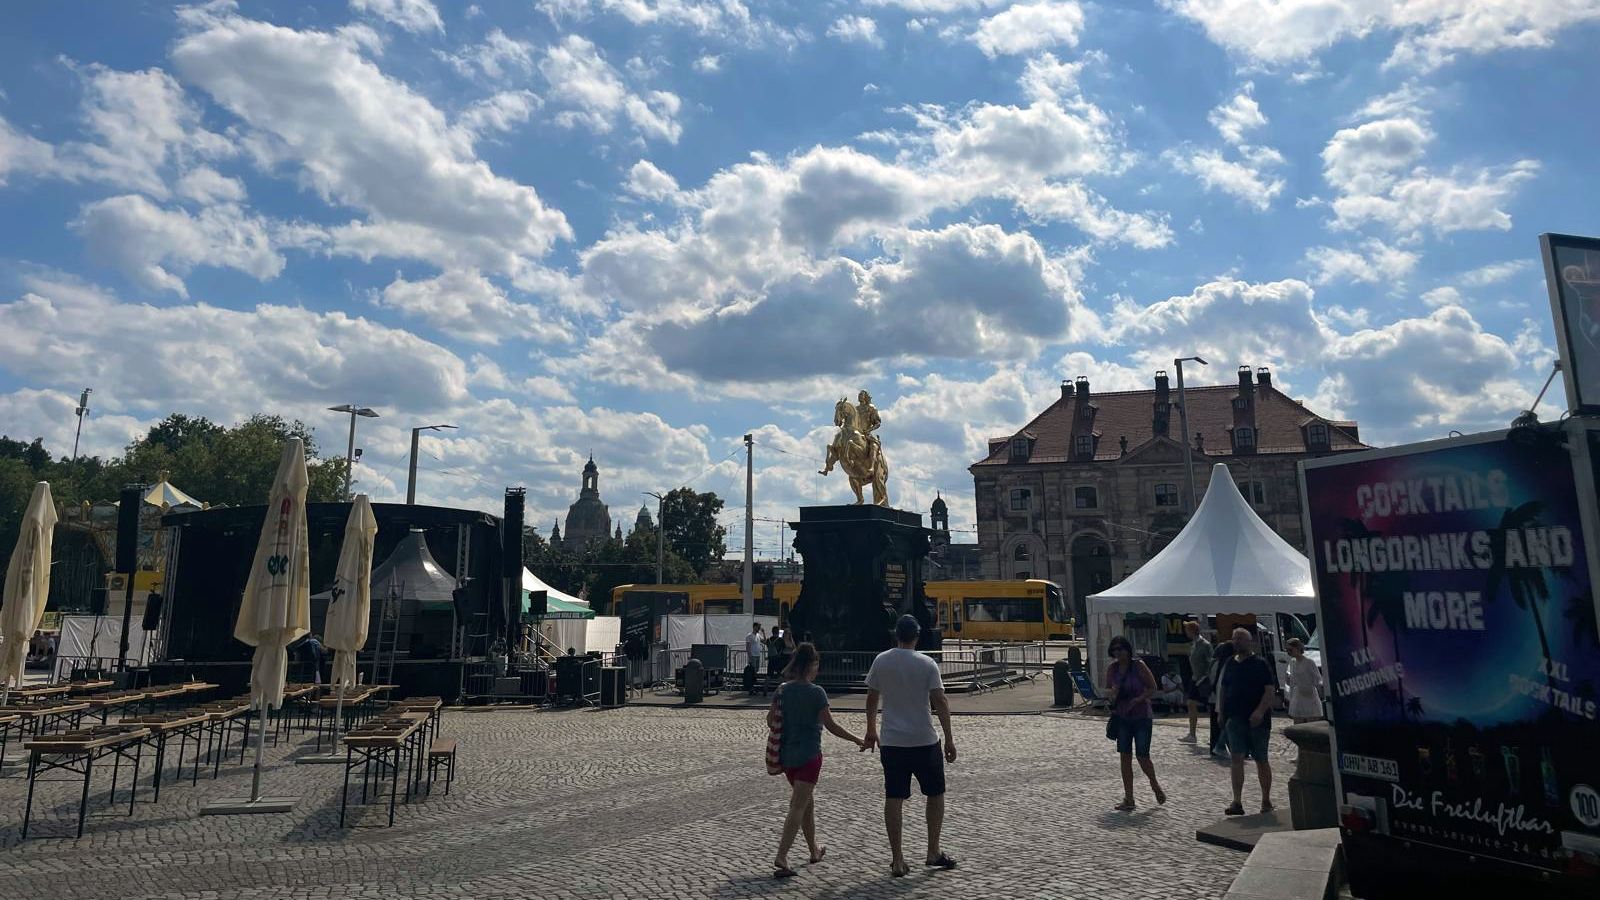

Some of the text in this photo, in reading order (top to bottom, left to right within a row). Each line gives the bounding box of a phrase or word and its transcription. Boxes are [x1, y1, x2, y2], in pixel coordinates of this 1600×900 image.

[1356, 469, 1508, 518] COCKTAILS
[1324, 525, 1574, 573] LONGDRINKS AND
[1403, 591, 1486, 631] MORE
[1350, 647, 1375, 667] XXL
[1335, 662, 1404, 697] LONGDRINKS
[1391, 783, 1554, 836] Die Freiluftbar
[1575, 791, 1599, 819] 100
